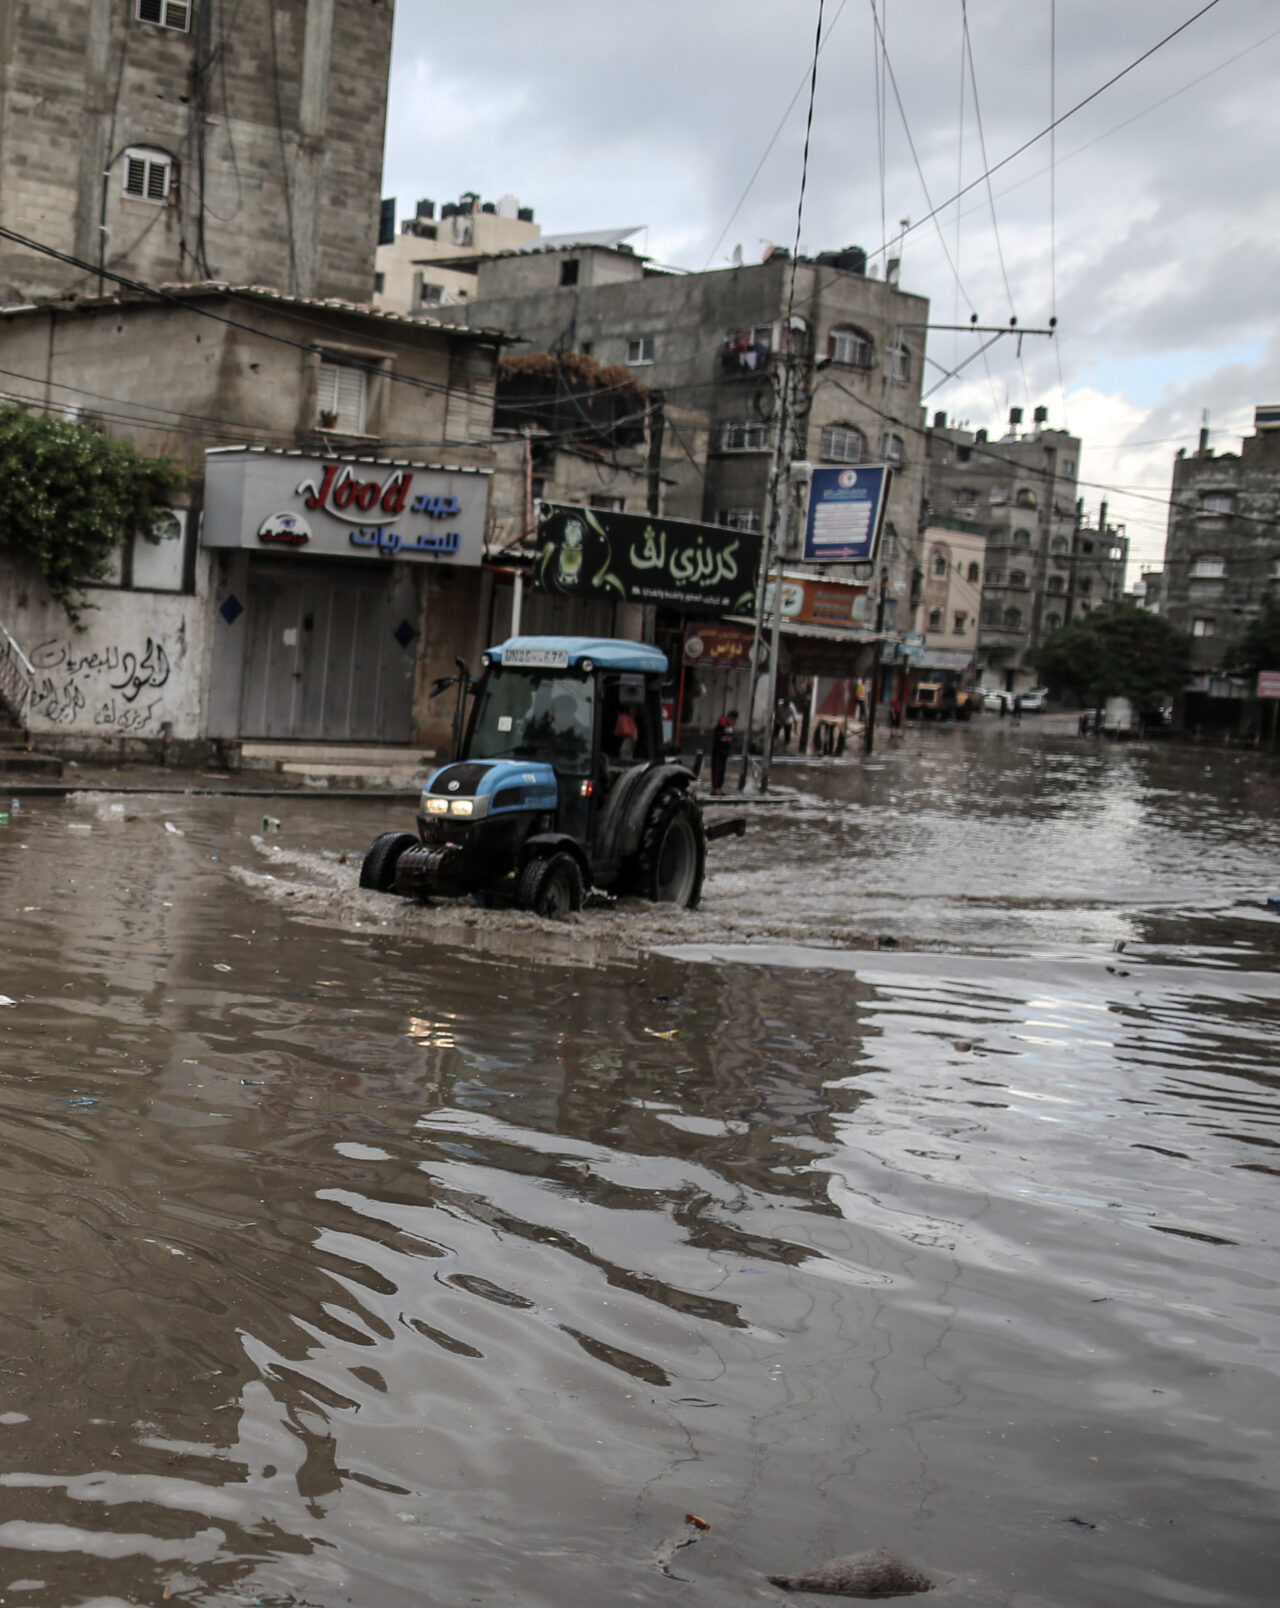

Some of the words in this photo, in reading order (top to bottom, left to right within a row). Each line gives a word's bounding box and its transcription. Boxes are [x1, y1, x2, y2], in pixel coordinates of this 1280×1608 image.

[306, 464, 414, 513] Jood
[412, 493, 461, 518] جود
[350, 525, 461, 558] للبصريات
[669, 535, 740, 588] كريزي
